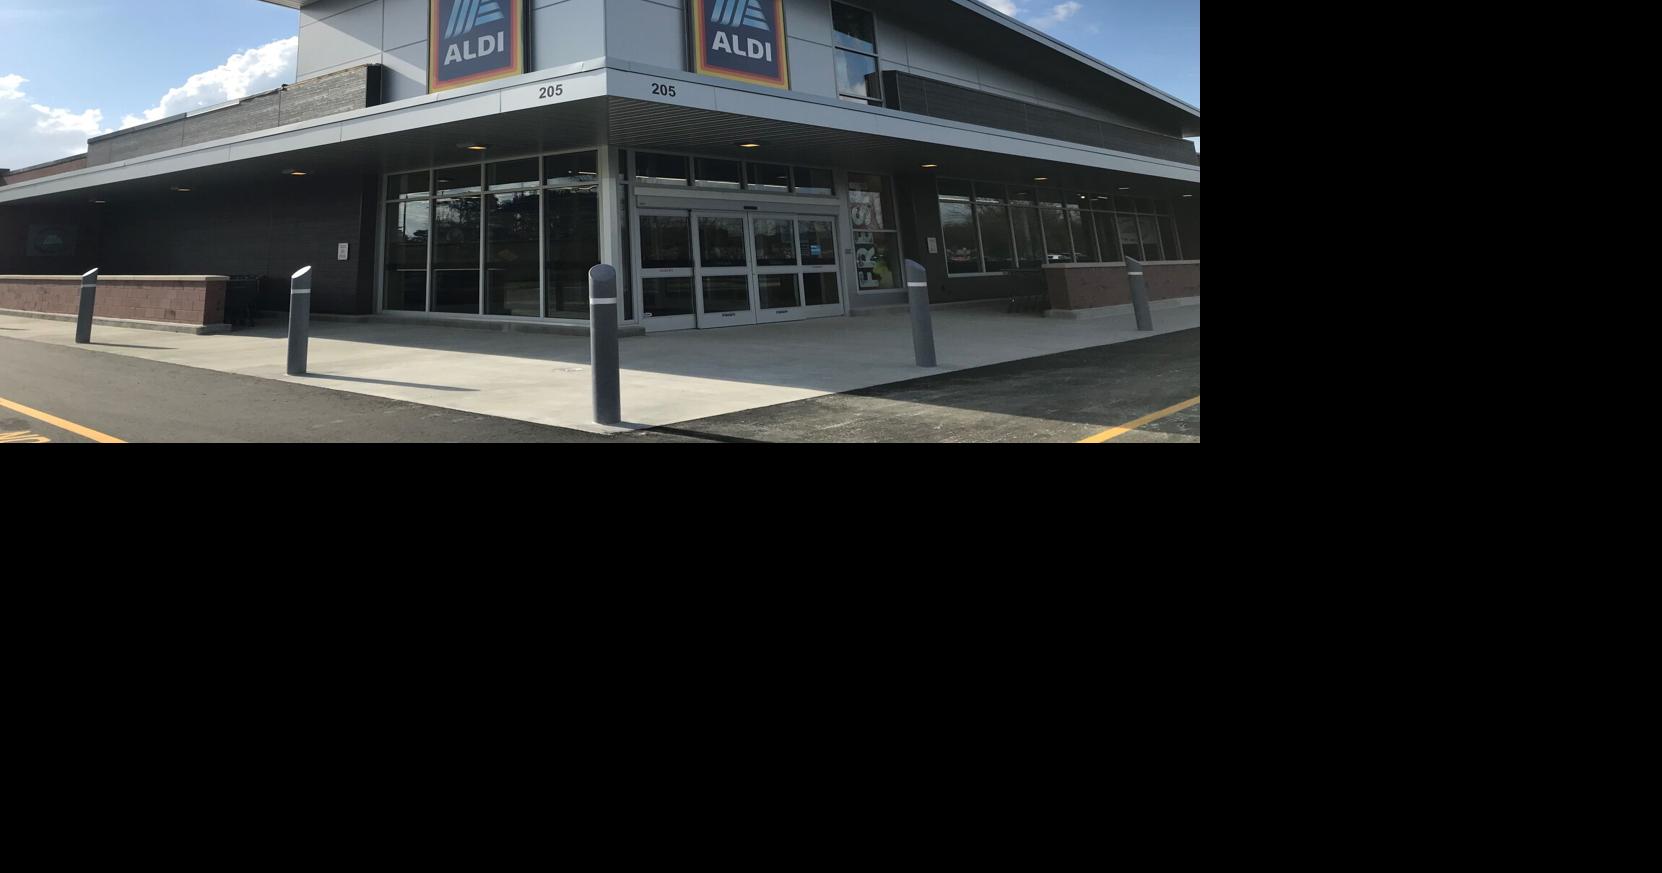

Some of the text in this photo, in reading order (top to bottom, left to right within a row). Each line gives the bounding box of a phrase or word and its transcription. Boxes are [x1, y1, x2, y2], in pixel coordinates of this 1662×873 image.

[443, 31, 504, 66] ALDI
[711, 31, 772, 62] ALDI
[539, 84, 564, 99] 205
[651, 82, 677, 97] 205
